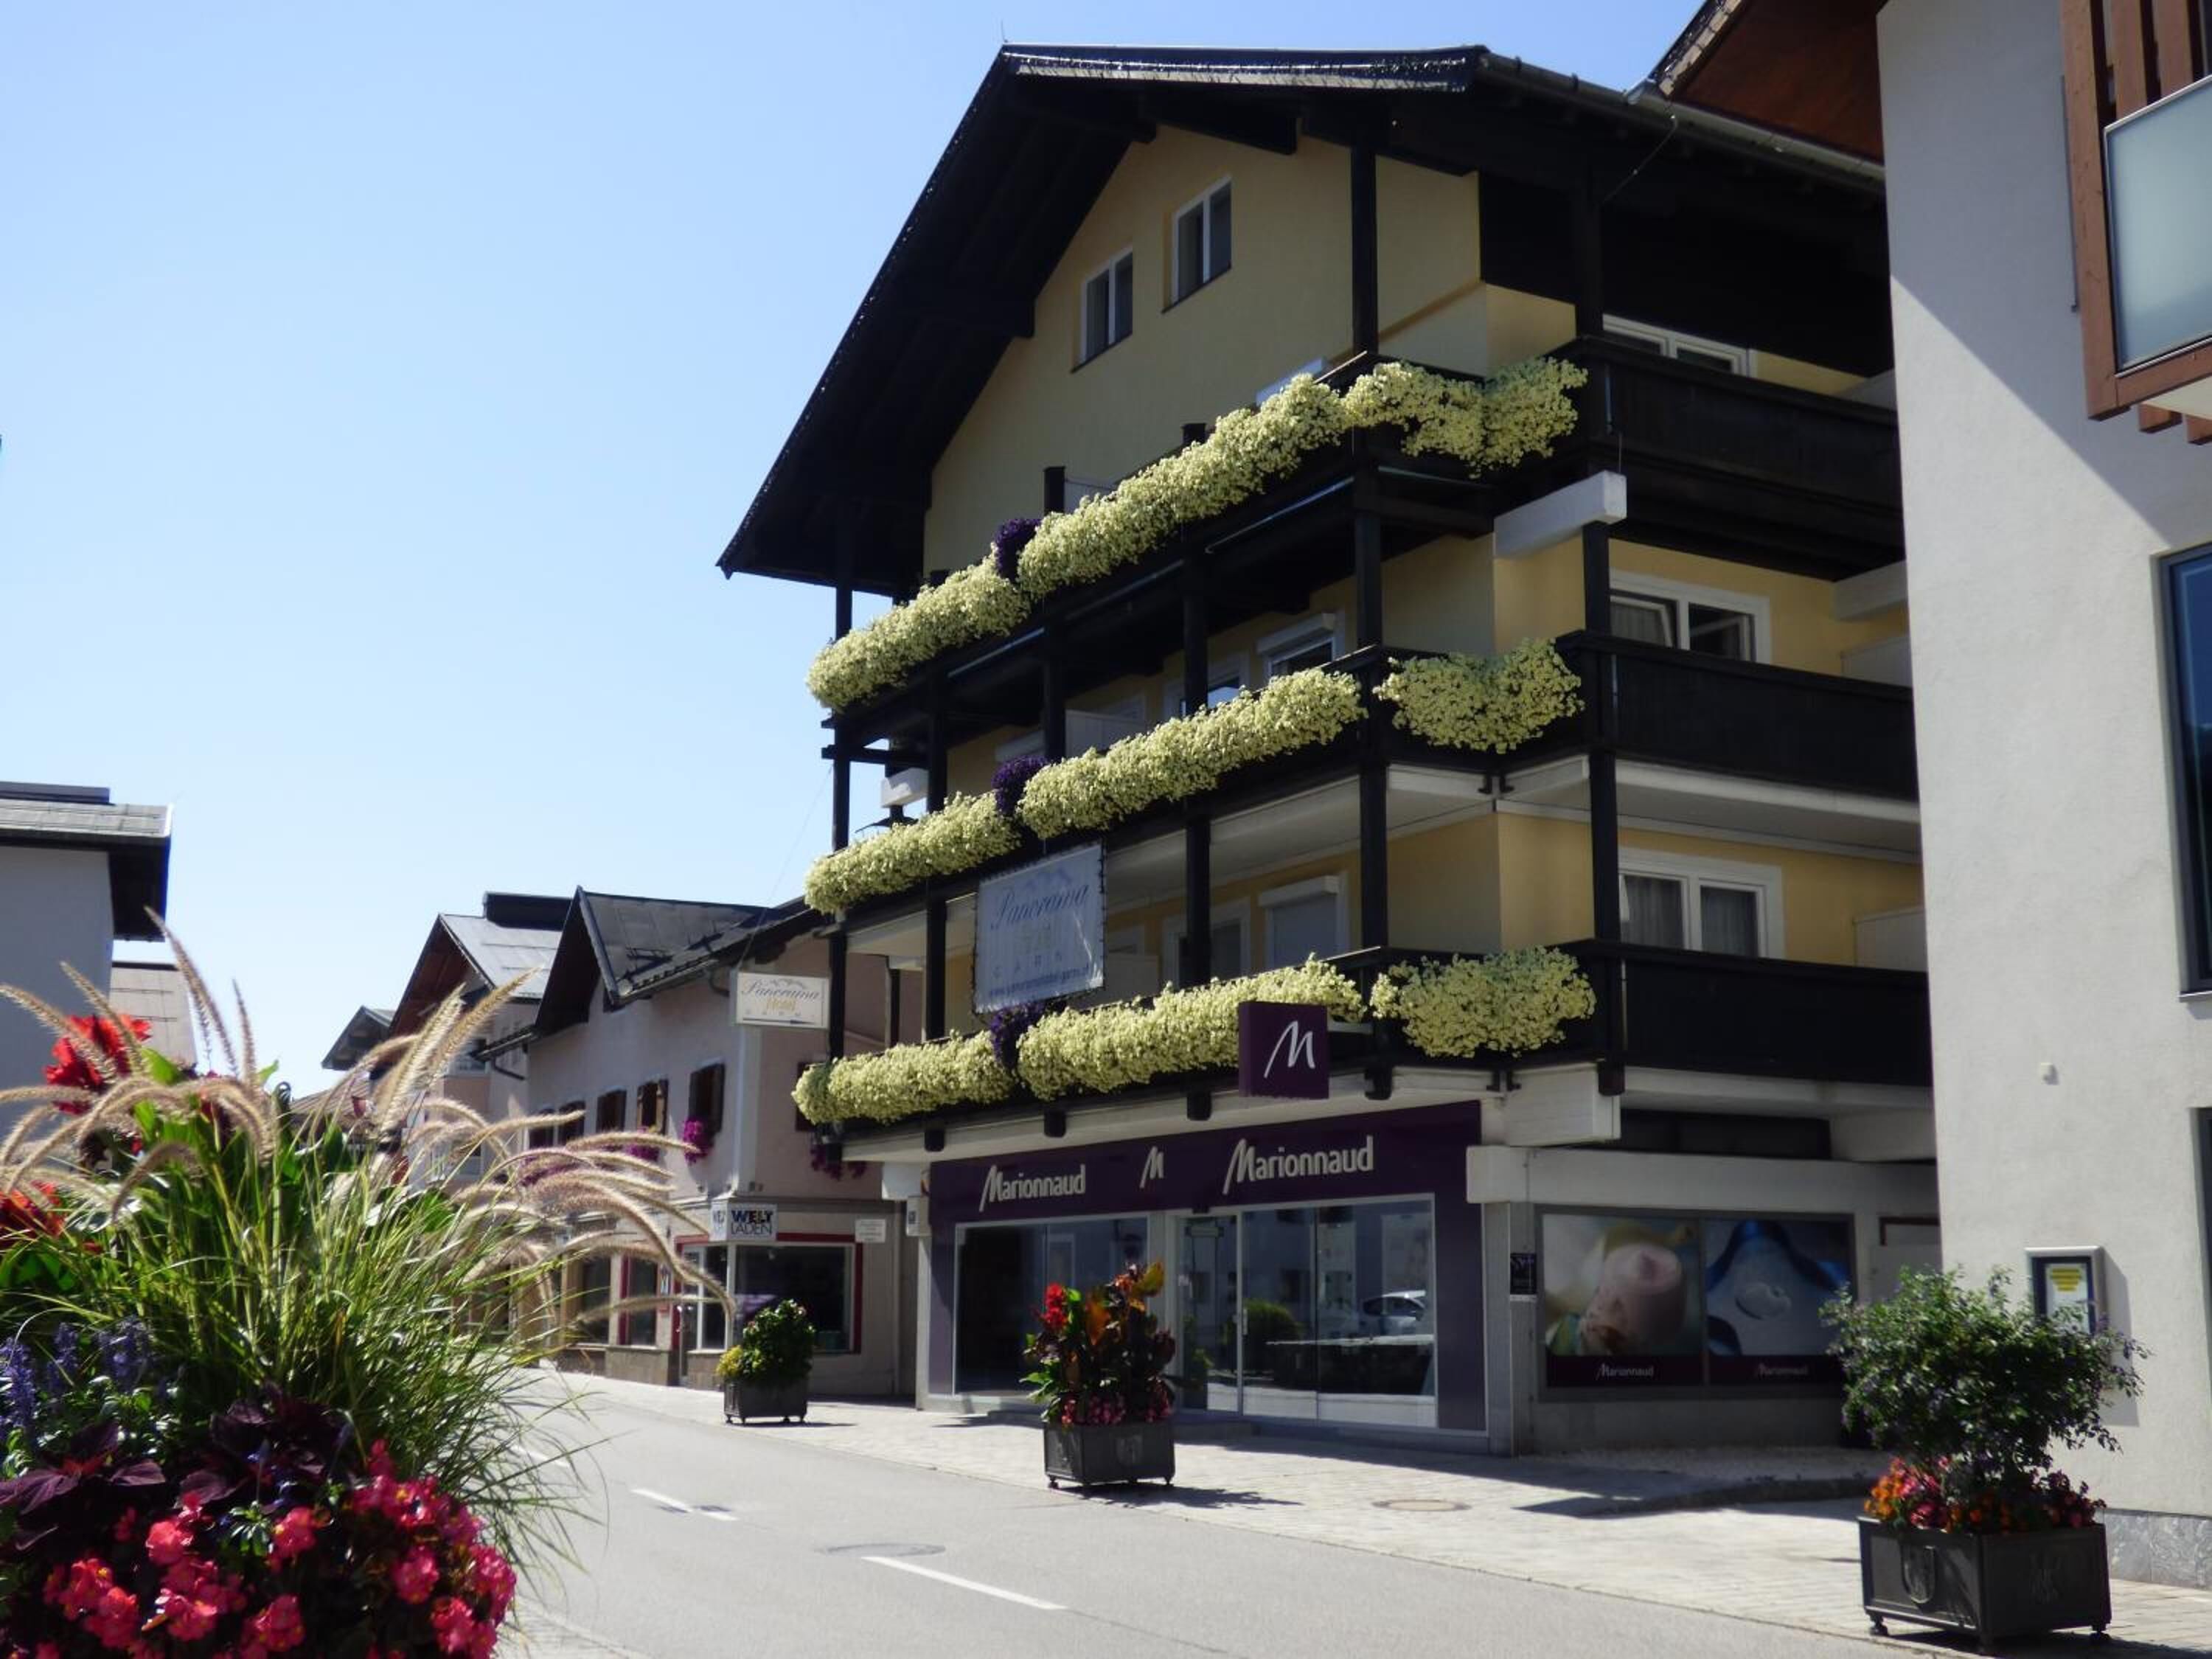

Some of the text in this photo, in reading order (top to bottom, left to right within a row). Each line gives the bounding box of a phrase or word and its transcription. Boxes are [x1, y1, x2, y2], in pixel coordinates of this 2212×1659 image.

[1263, 1020, 1316, 1078] M
[1140, 1146, 1164, 1188] M
[1222, 1135, 1374, 1195] Marionnaud
[978, 1164, 1086, 1212] Marionnaud
[731, 1210, 773, 1223] WELT
[731, 1222, 772, 1235] LADEN
